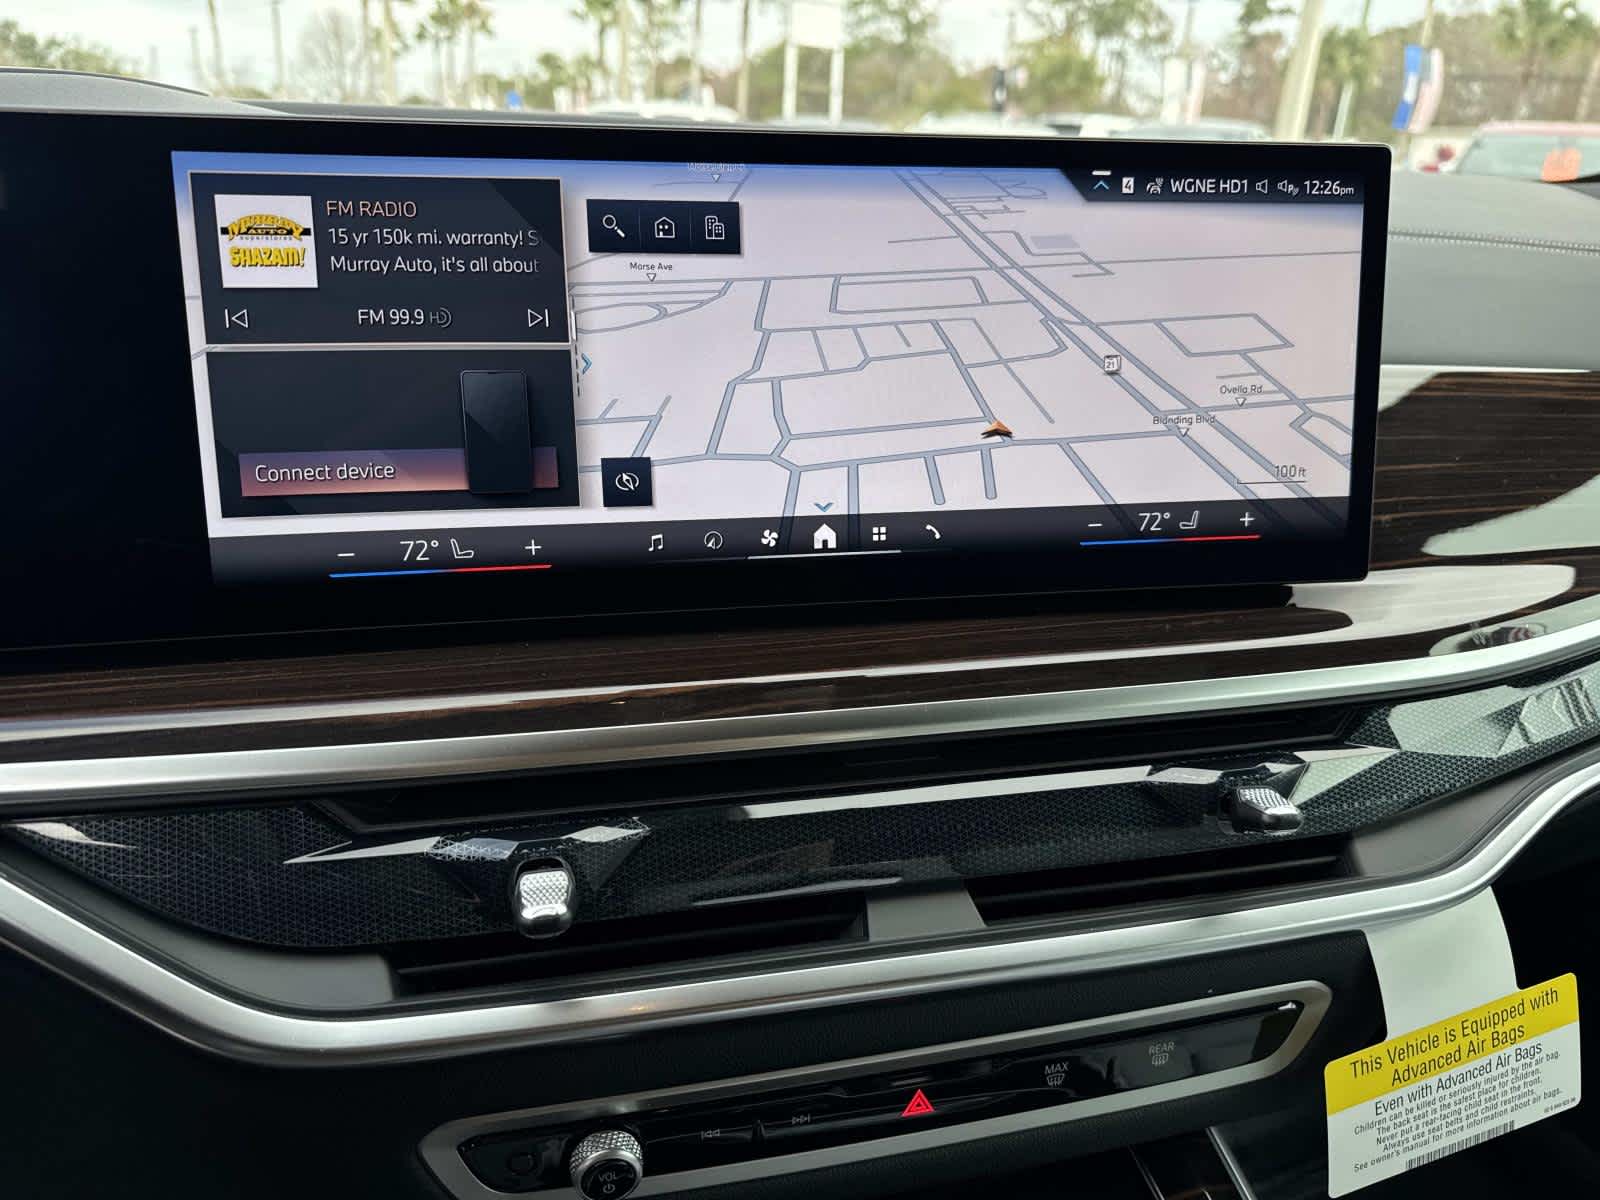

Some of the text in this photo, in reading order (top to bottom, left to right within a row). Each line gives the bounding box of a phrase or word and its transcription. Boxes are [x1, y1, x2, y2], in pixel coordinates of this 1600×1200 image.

[1170, 178, 1248, 193] WGNE HD1
[1303, 180, 1354, 196] 12:26pm
[327, 200, 417, 218] FM RADIO
[328, 228, 348, 244] 15
[352, 232, 369, 247] yr
[373, 228, 413, 245] 150k
[418, 230, 443, 245] mi.
[446, 230, 523, 248] warranty!
[230, 247, 306, 268] SHAZAM!
[331, 256, 540, 274] Murray Auto, it's all about
[629, 262, 673, 271] Morse Ave
[358, 309, 384, 325] FM
[389, 309, 424, 325] 99.9
[1105, 360, 1116, 370] 21
[1250, 385, 1263, 394] Rd
[1152, 414, 1216, 427] Blanding Blvd
[255, 463, 395, 482] Connect device
[1275, 465, 1307, 479] 100 ft
[1138, 512, 1171, 531] 72°
[400, 540, 439, 561] 72°
[1350, 988, 1559, 1079] This Vehicle is Equipped with
[1149, 1042, 1175, 1055] REAR
[1391, 1024, 1525, 1086] Advanced Air Bags
[1044, 1061, 1069, 1074] MAX
[1375, 1043, 1542, 1116] Even with Advanced Air Bags
[1354, 1050, 1561, 1135] Children can be killed or seriously injured by the air bag.
[1377, 1067, 1542, 1136] The back seat is the safest place for children.
[1376, 1131, 1398, 1145] Never
[1400, 1125, 1413, 1139] put
[1464, 1098, 1483, 1113] child
[1484, 1093, 1499, 1106] seat
[1501, 1089, 1508, 1098] in
[1510, 1083, 1521, 1094] the
[1354, 1160, 1368, 1173] See
[1370, 1149, 1401, 1165] owner's
[1403, 1136, 1430, 1154] manual
[1432, 1130, 1443, 1142] for
[1445, 1124, 1464, 1138] more
[1466, 1105, 1508, 1129] information
[1510, 1098, 1531, 1113] about
[1532, 1095, 1542, 1105] air
[1383, 1138, 1410, 1153] Always
[1412, 1130, 1425, 1141] use
[1427, 1124, 1443, 1137] seat
[1445, 1115, 1463, 1130] belts
[1465, 1109, 1479, 1122] and
[1480, 1101, 1499, 1116] child
[598, 1170, 618, 1182] VOL
